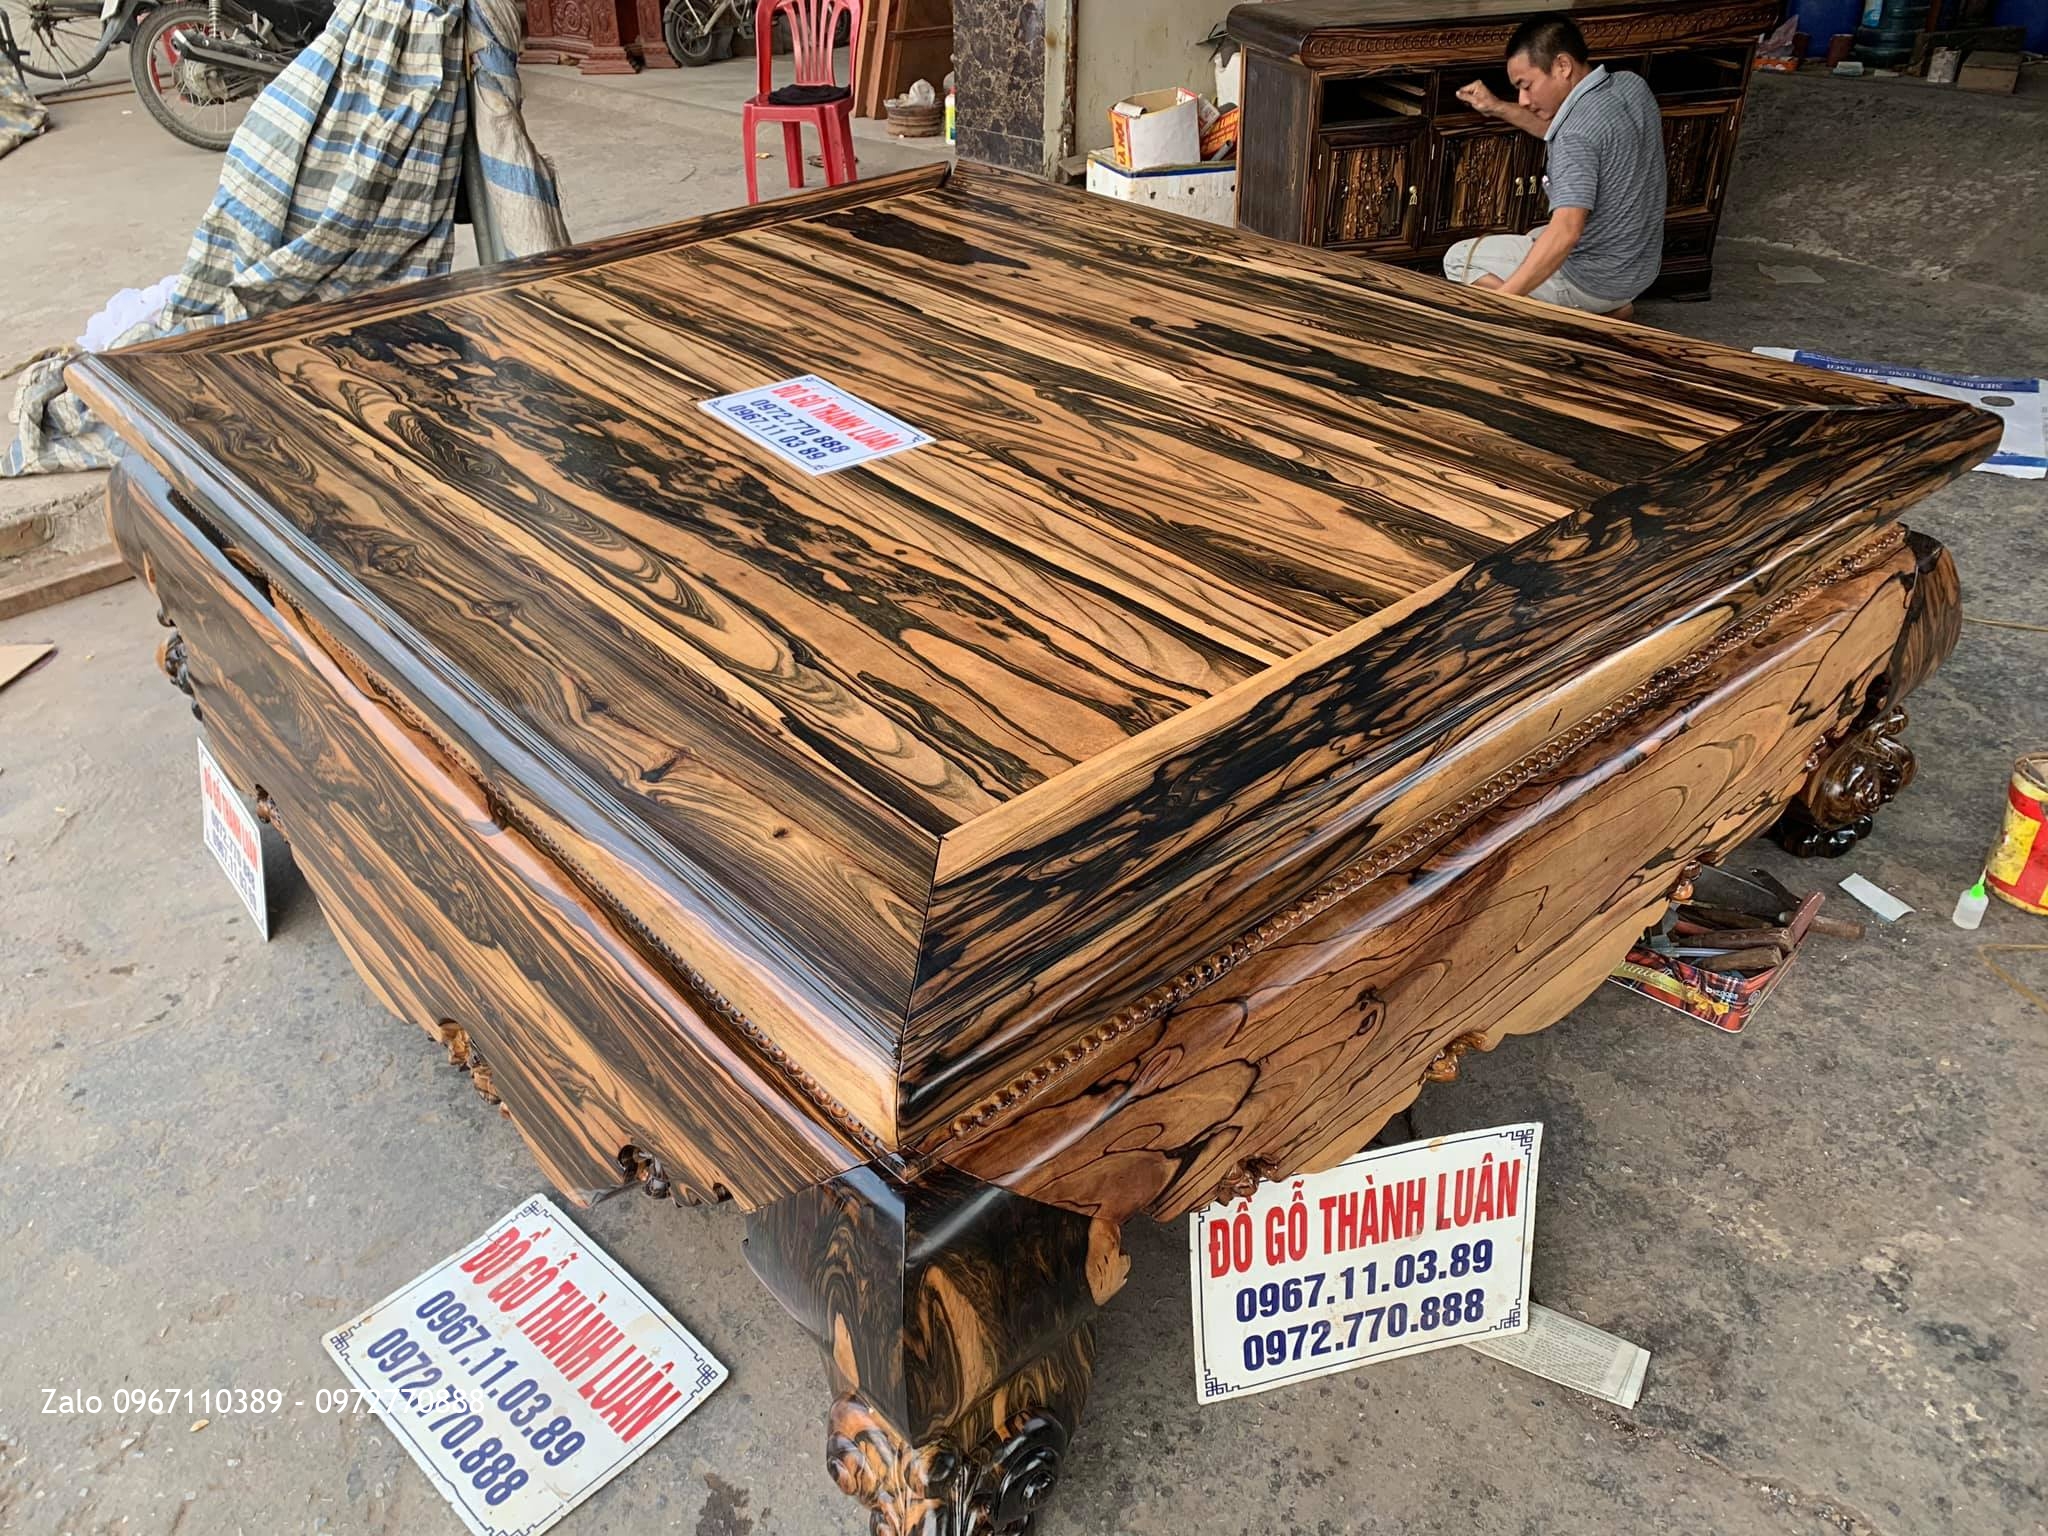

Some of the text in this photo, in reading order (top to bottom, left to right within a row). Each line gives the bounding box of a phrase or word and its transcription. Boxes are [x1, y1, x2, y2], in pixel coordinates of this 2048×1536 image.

[807, 403, 866, 432] THÀNH
[846, 425, 904, 452] LUÂN
[1208, 1152, 1522, 1279] ĐỒ GỖ THÀNH LUÂN
[460, 1226, 683, 1443] ĐỒ GỖ THÀNH LUÂN
[1236, 1238, 1495, 1323] 0967.11.03.89
[1242, 1288, 1485, 1372] 0972.770.888
[367, 1328, 530, 1506] 0972.770.888
[415, 1290, 586, 1467] 0967.11.03.89
